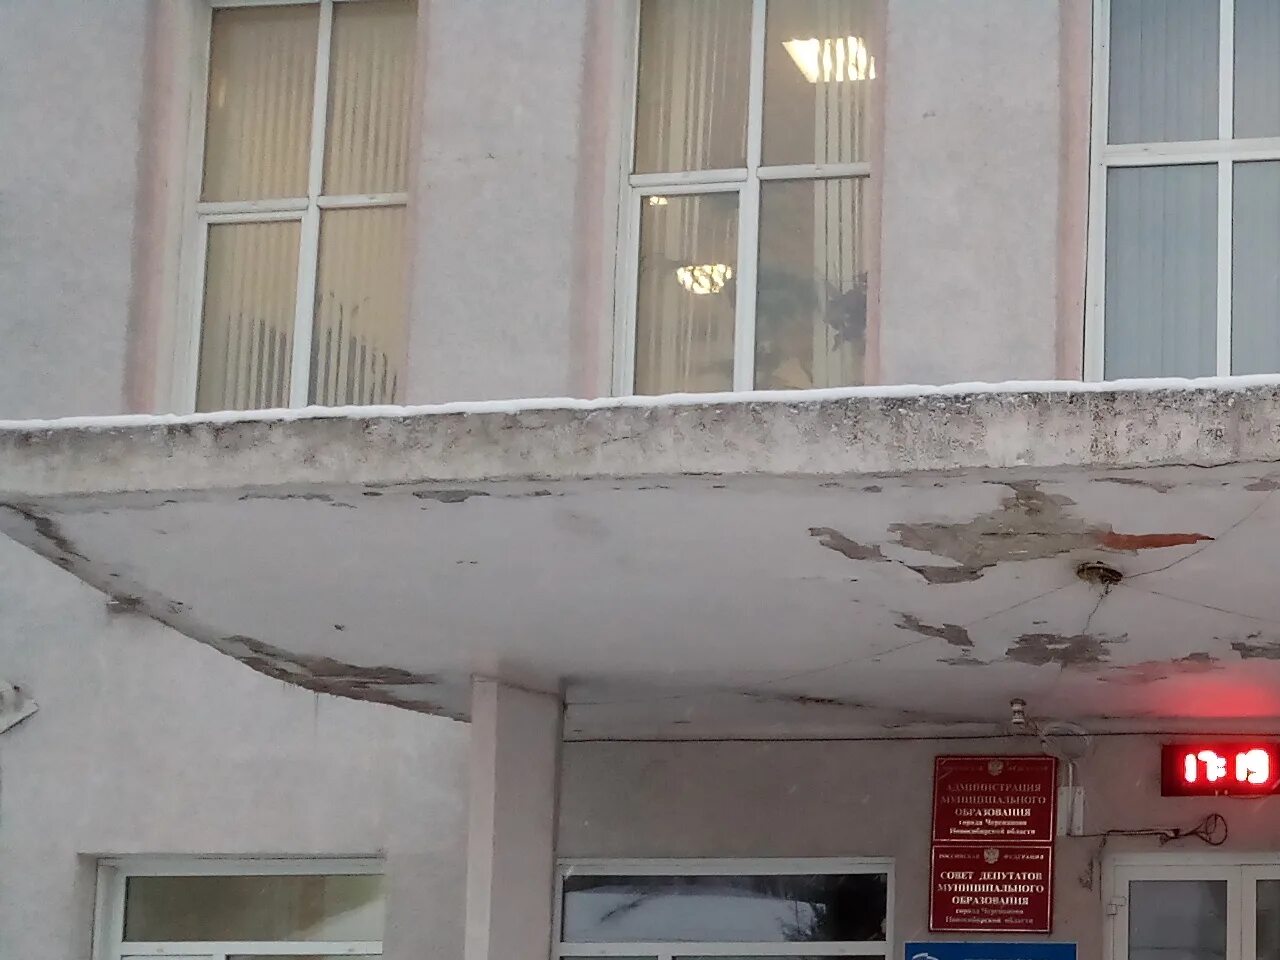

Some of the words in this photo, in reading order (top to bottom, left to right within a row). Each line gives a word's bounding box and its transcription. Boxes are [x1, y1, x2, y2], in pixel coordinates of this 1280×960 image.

[947, 783, 1041, 792] АДМИНИСТРАЦИЯ
[942, 796, 1046, 804] МУНИЦИПАЛЬНОГО
[955, 808, 1031, 817] ОБРАЗОВАНИЯ
[940, 871, 974, 880] СОВЕТ
[978, 871, 1043, 881] ДЕПУТАТОВ
[937, 884, 1044, 892] МУНИЦИПАЛЬНОГО
[952, 896, 1029, 905] ОБРАЗОВАНИЯ
